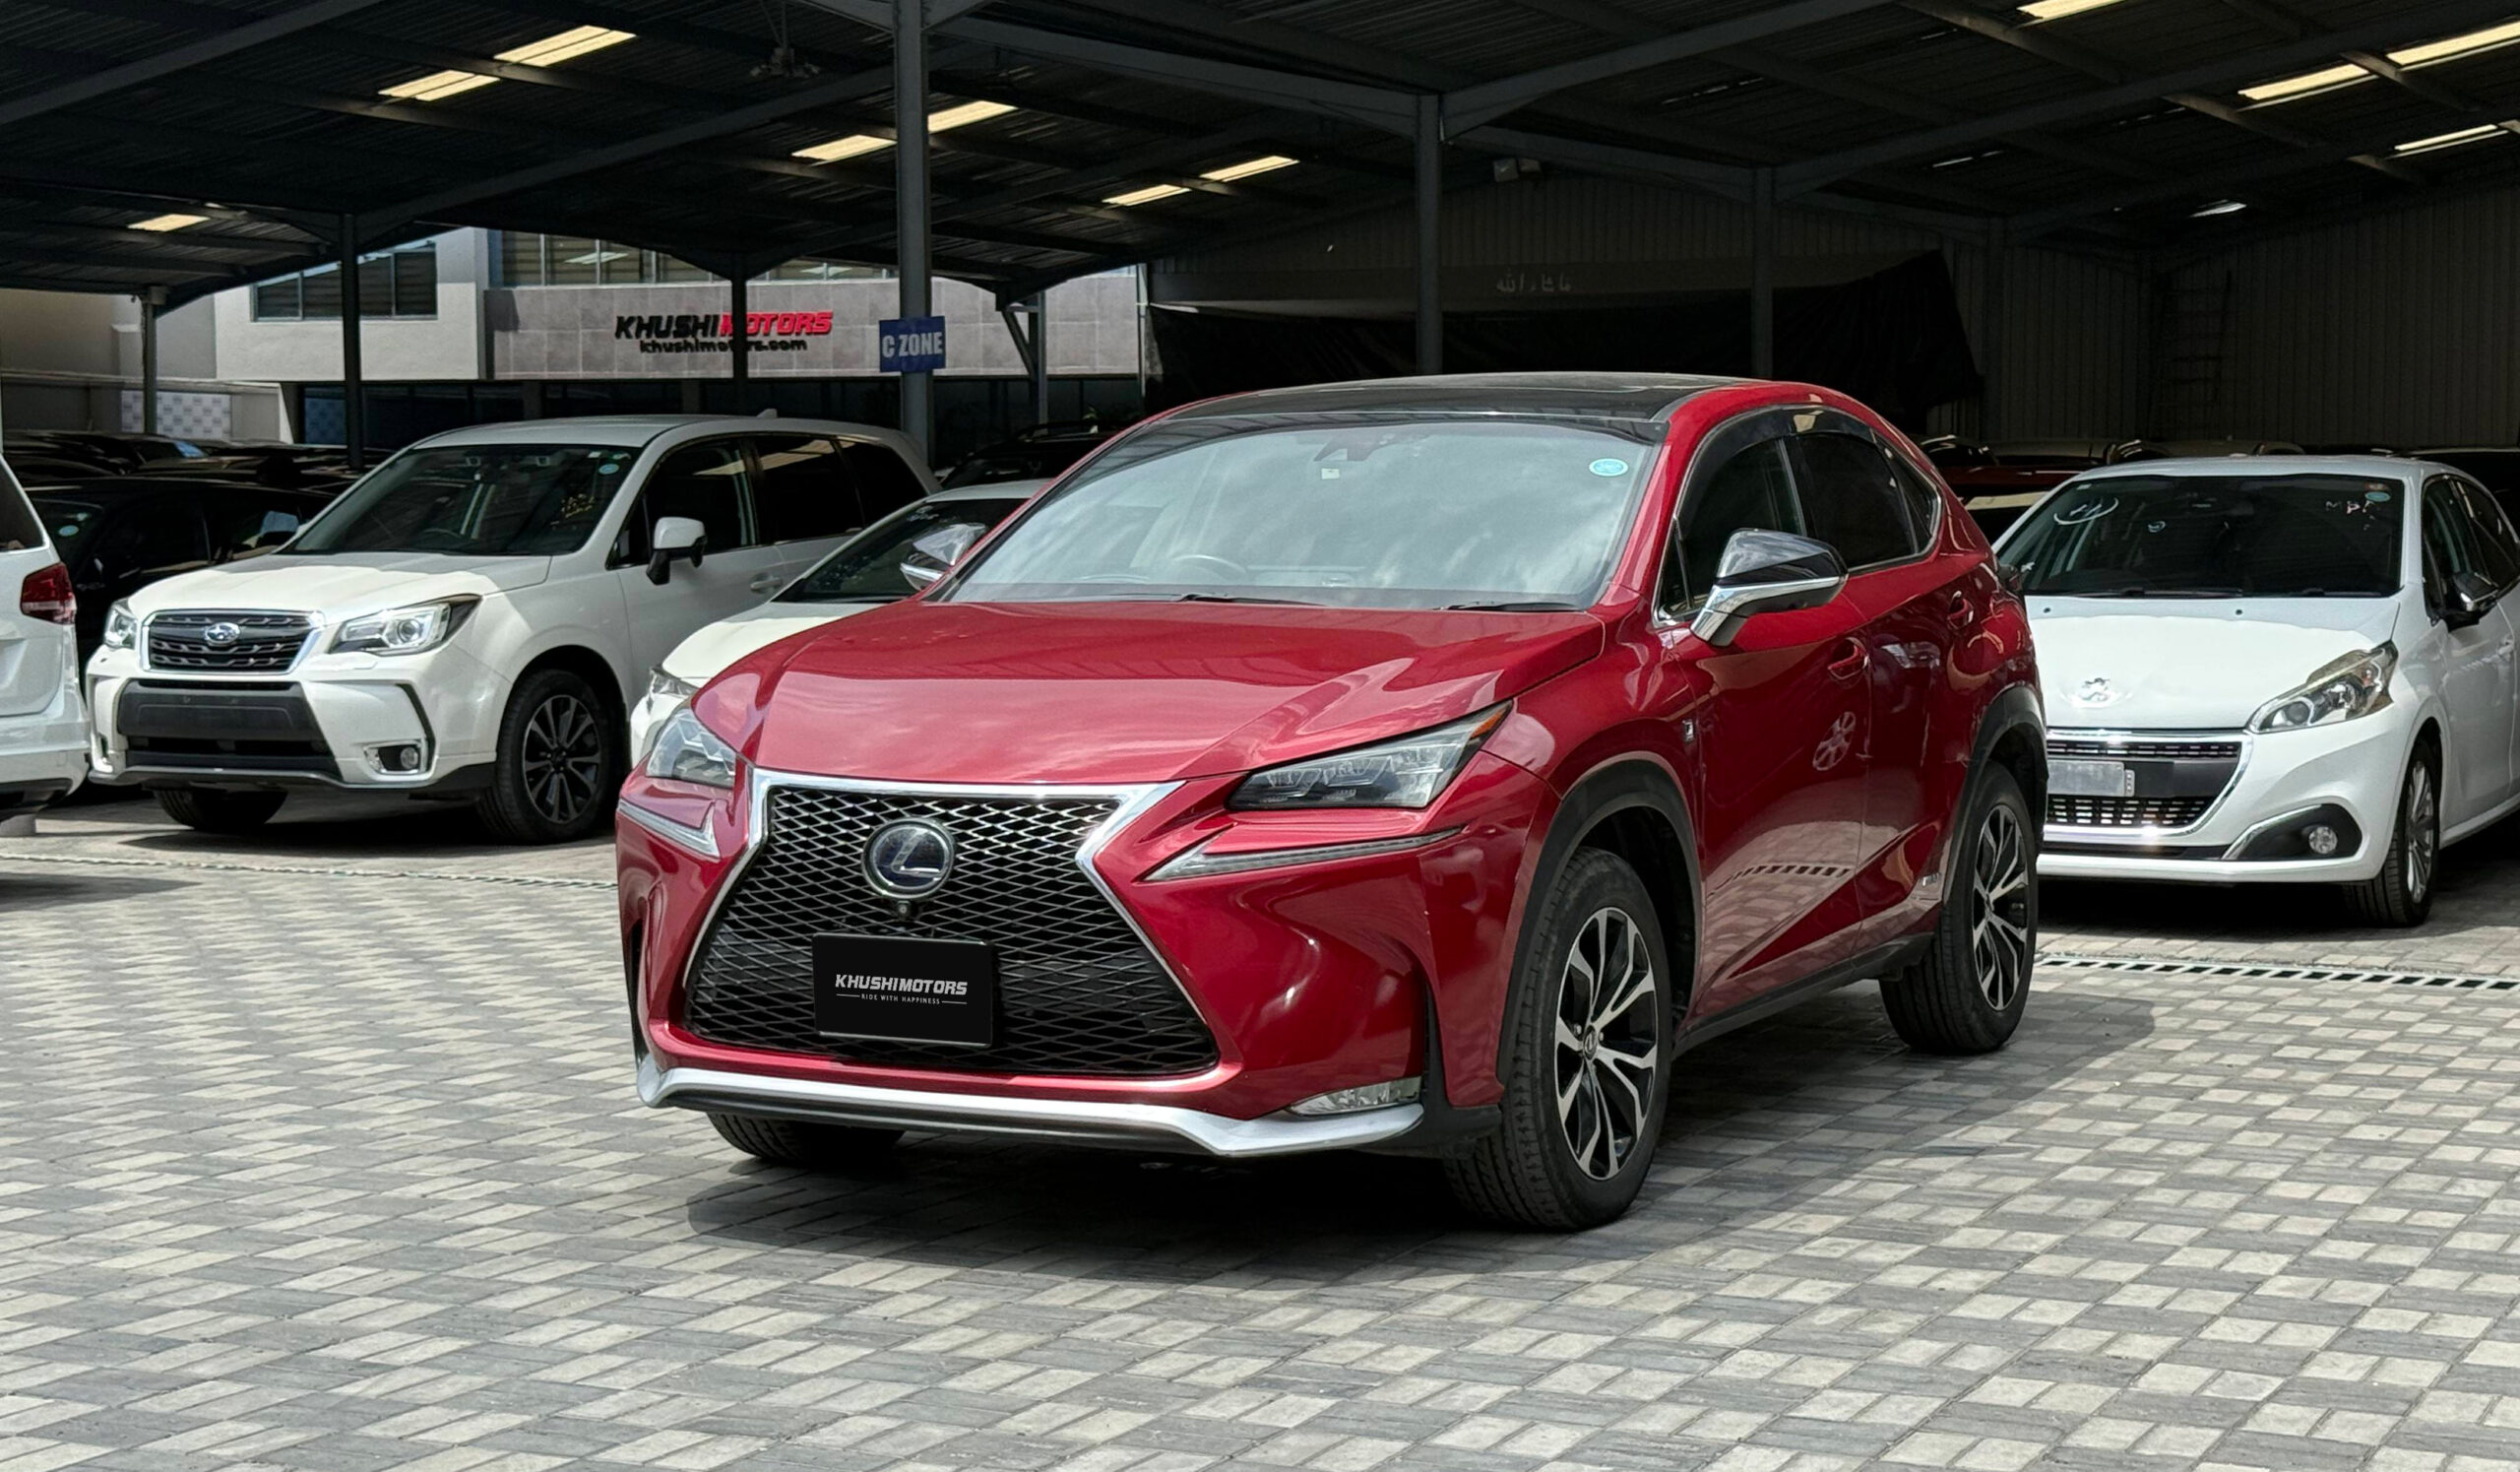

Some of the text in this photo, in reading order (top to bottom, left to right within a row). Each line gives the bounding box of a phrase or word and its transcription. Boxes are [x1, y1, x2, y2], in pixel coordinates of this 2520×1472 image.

[1495, 267, 1526, 292] الله
[640, 338, 807, 353] khushimotrs.com
[882, 331, 943, 358] C ZONE
[860, 992, 878, 1001] RIDE
[901, 995, 940, 1005] HAPPINESS
